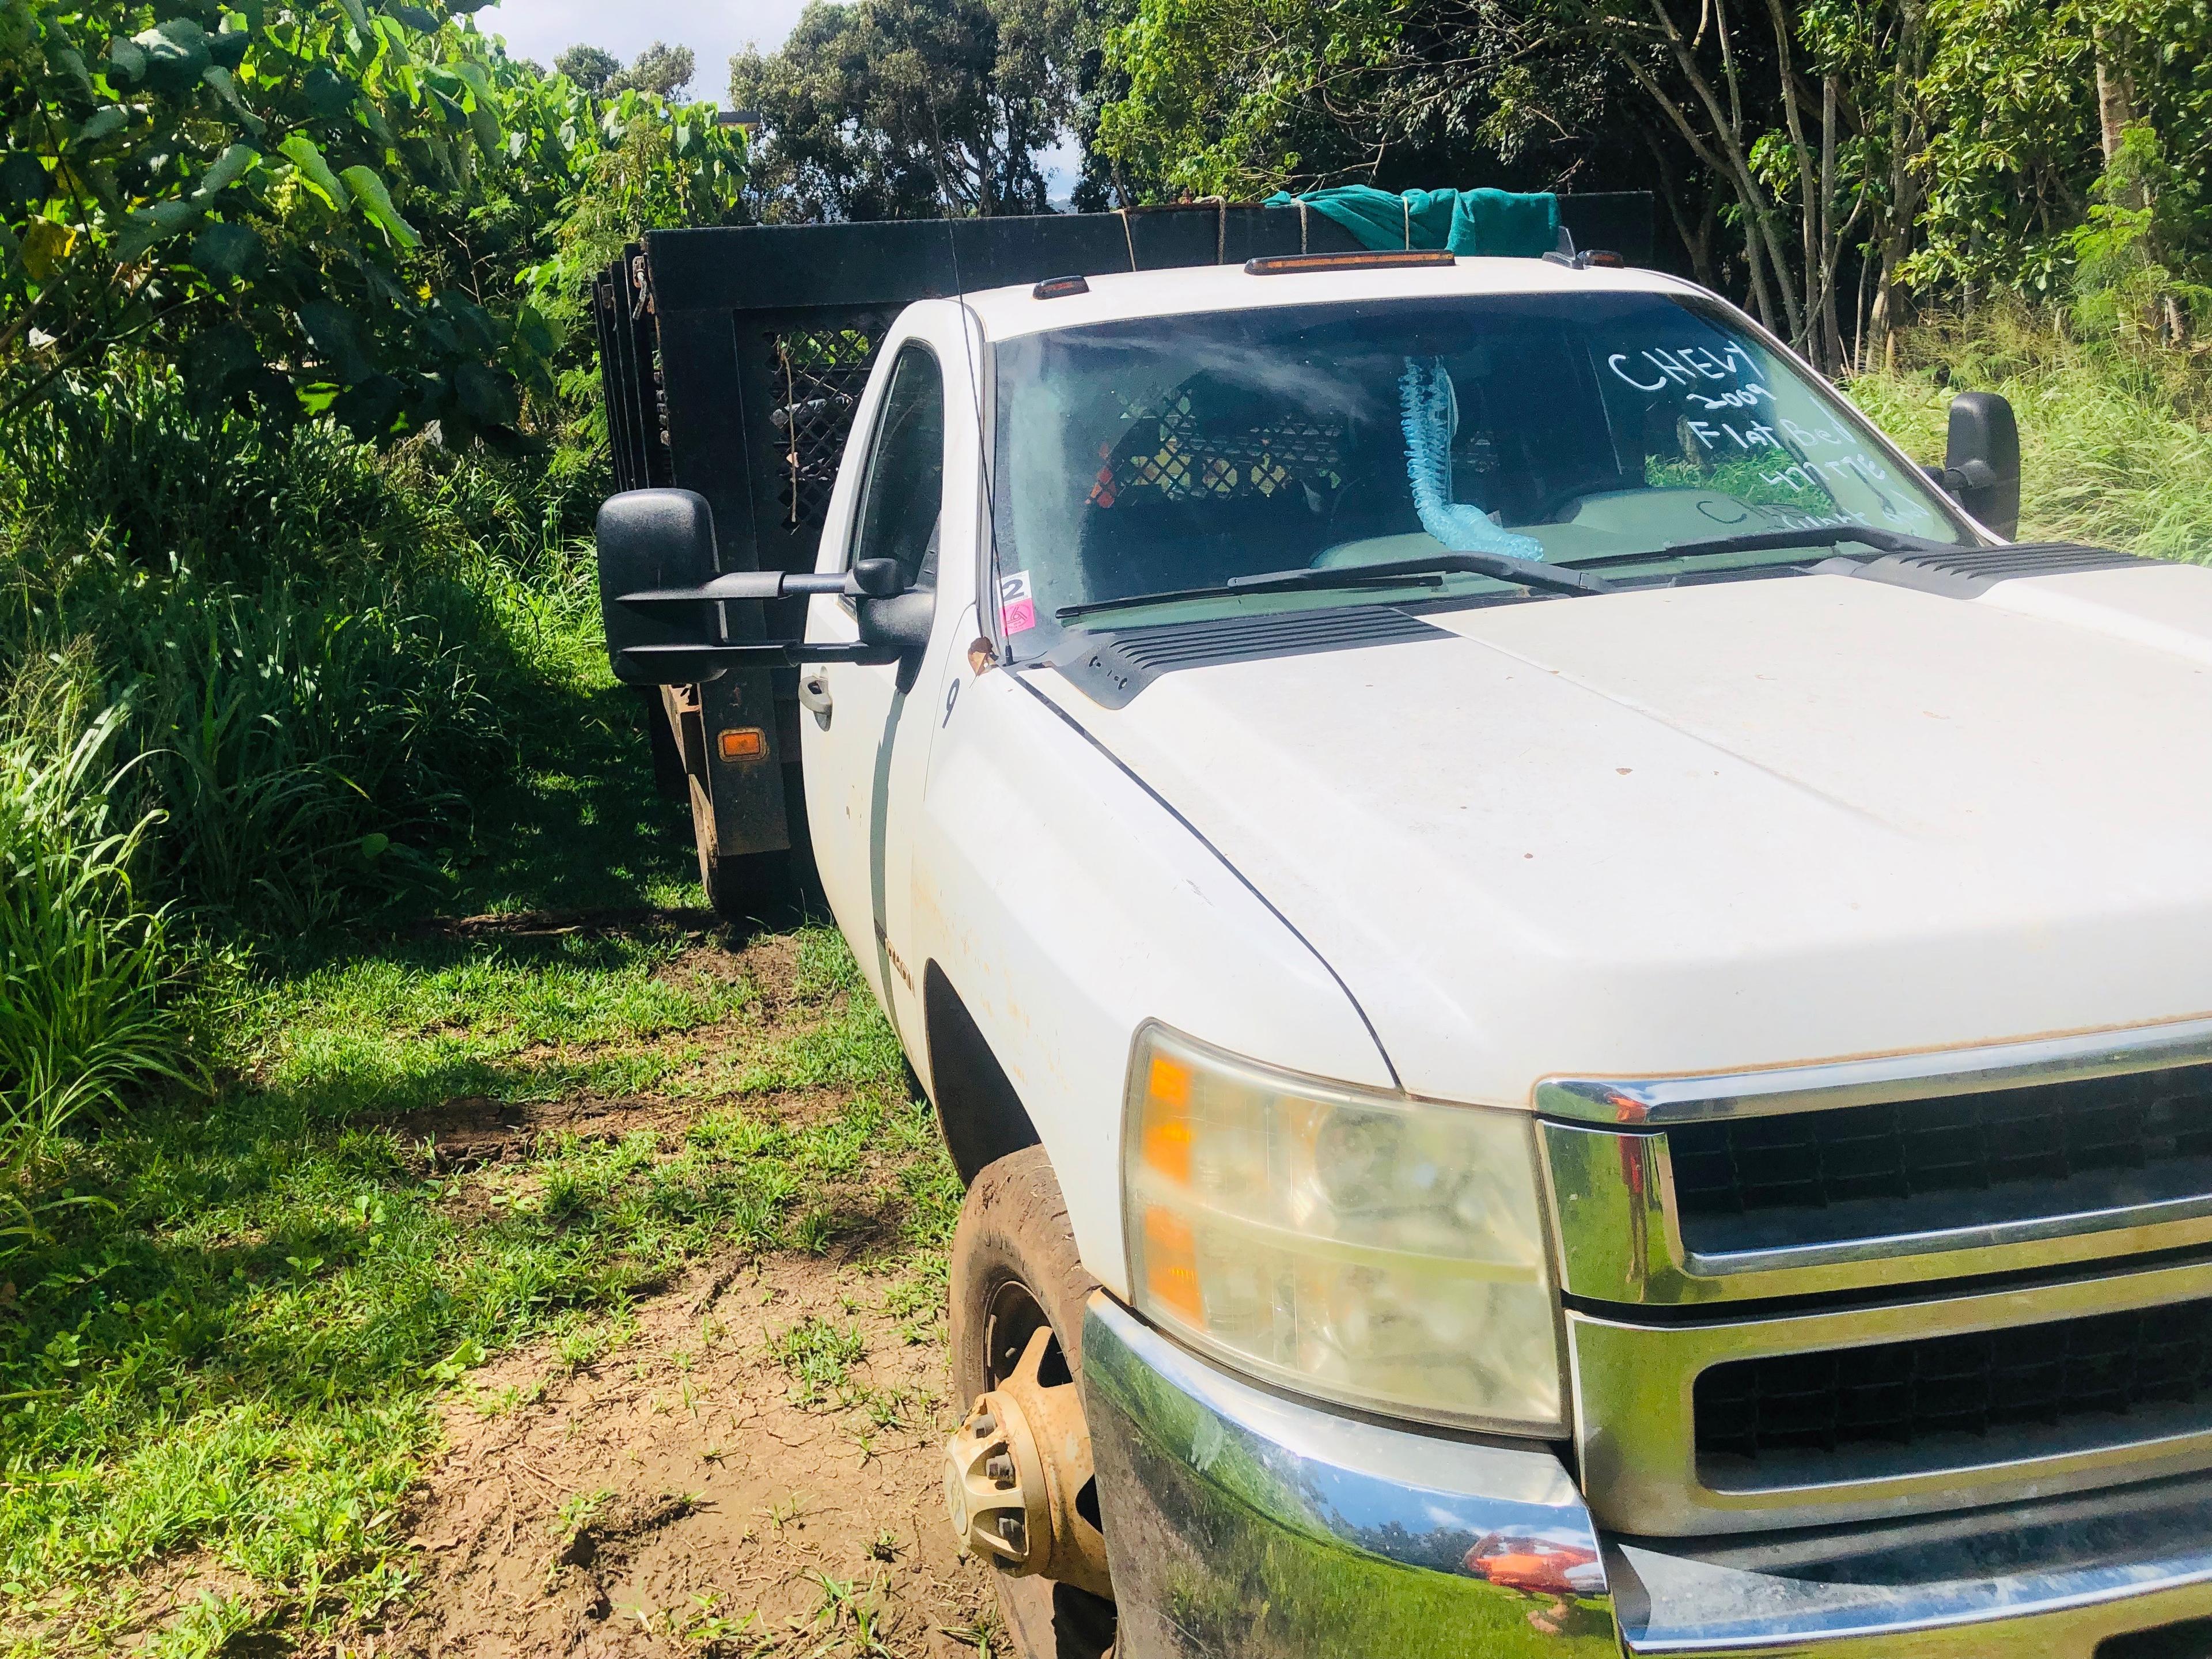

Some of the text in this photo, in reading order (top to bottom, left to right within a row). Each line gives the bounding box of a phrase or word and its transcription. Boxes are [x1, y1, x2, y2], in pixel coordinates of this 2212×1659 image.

[1608, 340, 1766, 391] CHEVY
[1685, 383, 1778, 410] 2009
[1687, 396, 1857, 449] Flat Bed
[1002, 578, 1025, 602] 2
